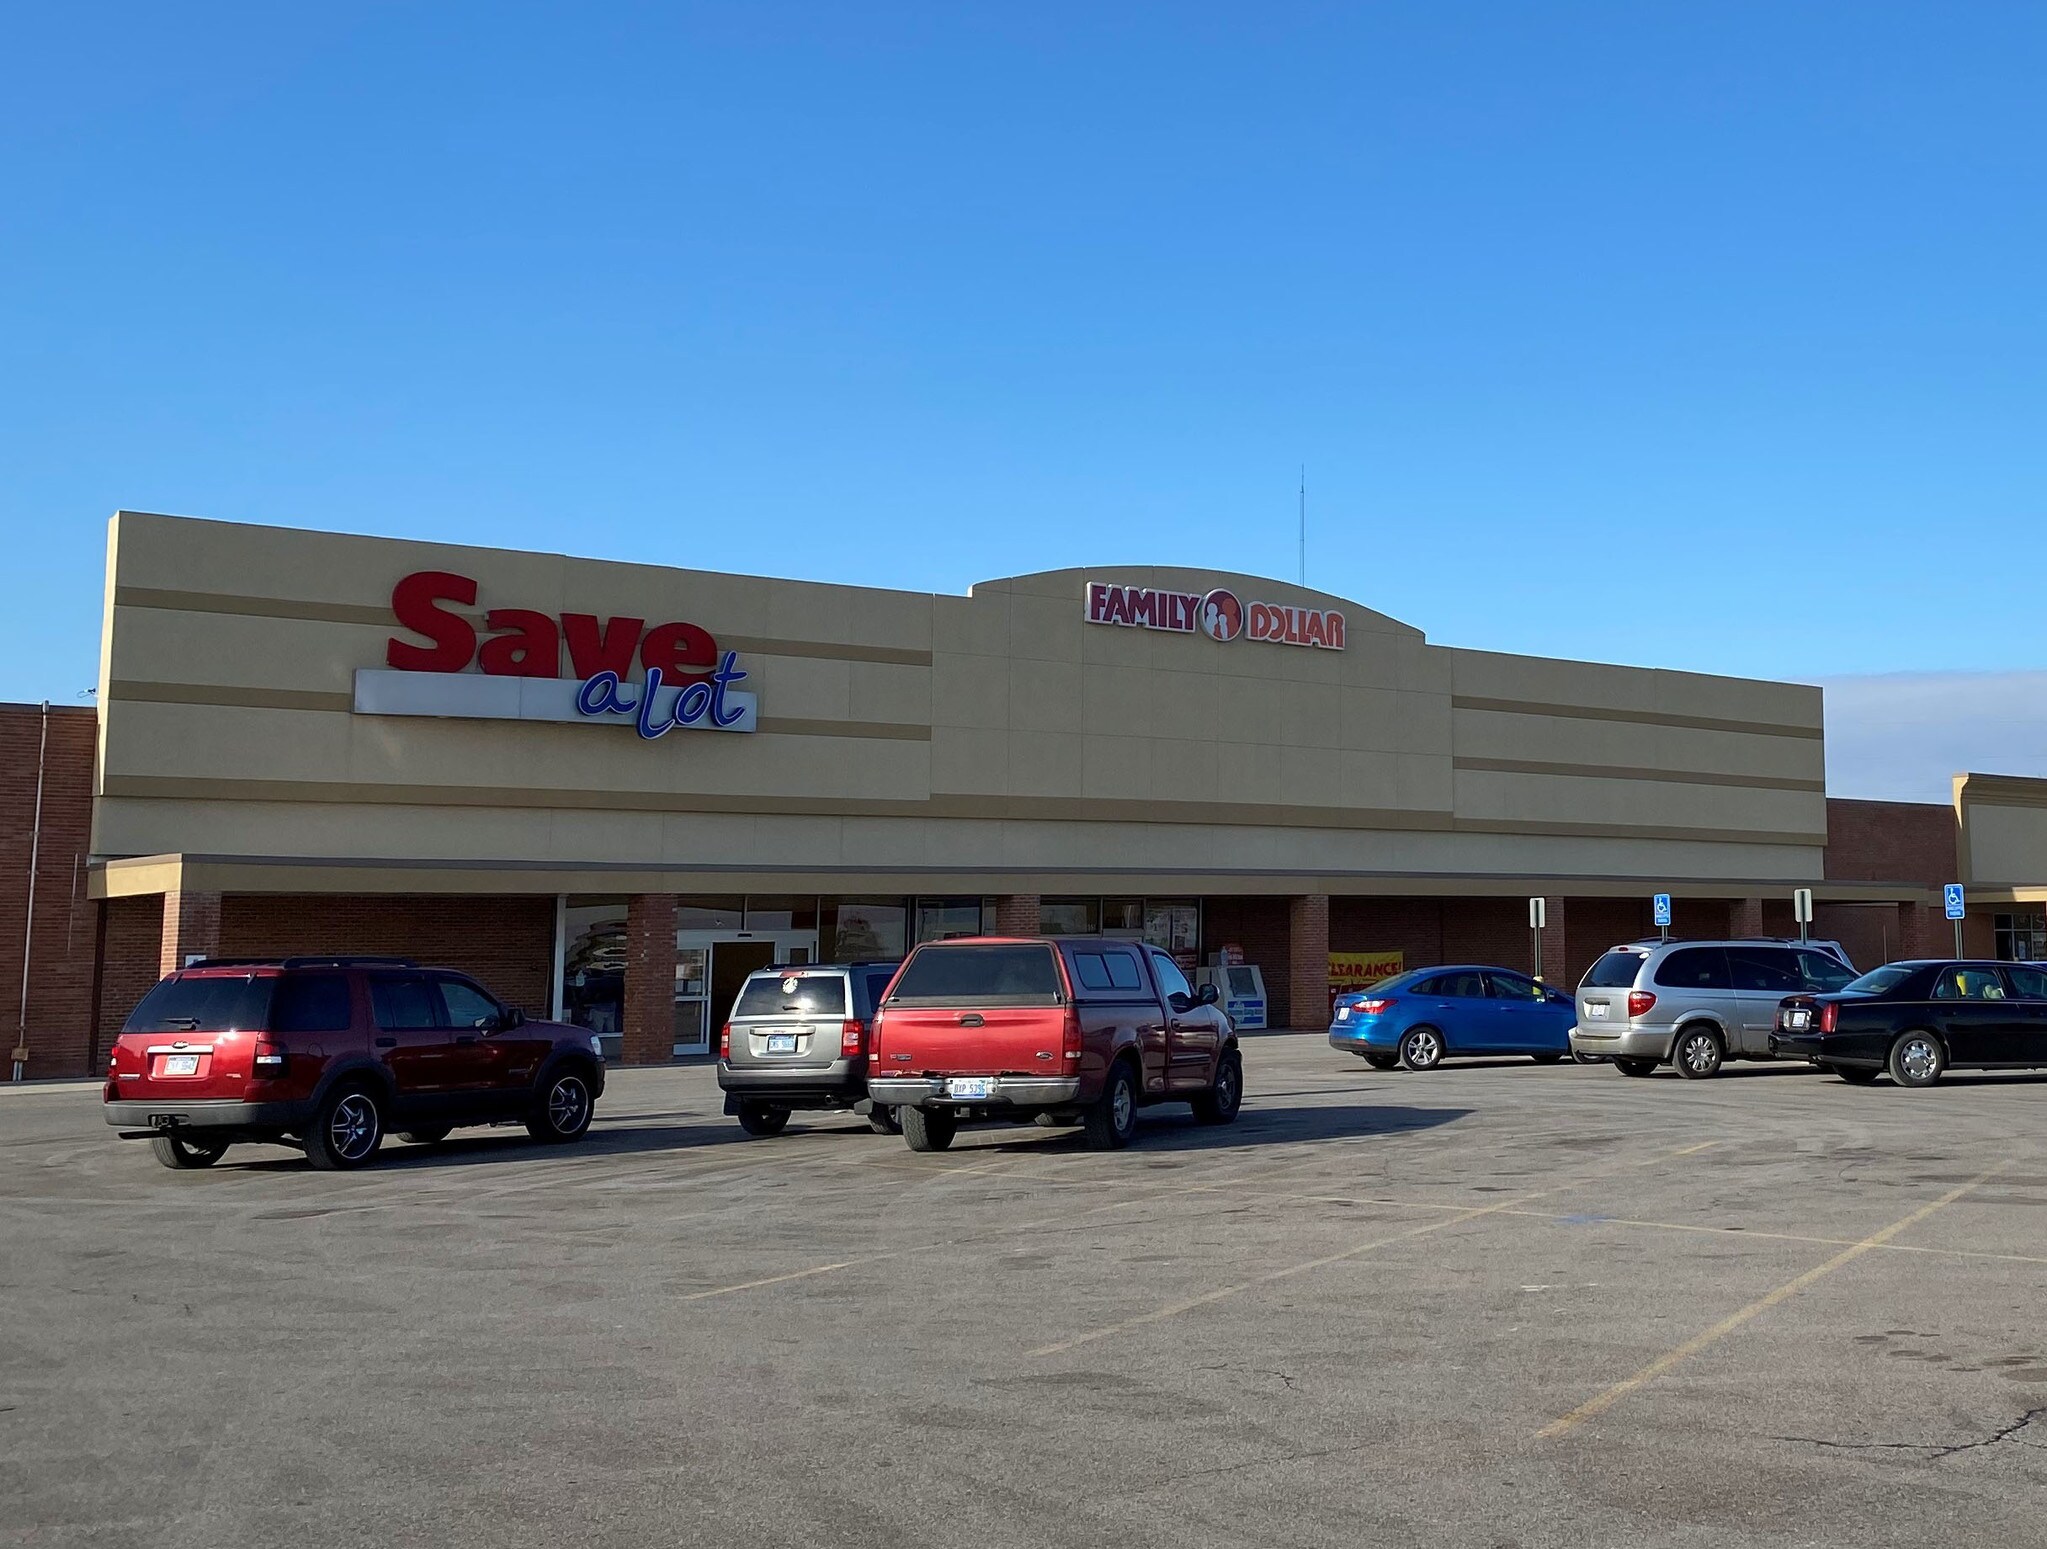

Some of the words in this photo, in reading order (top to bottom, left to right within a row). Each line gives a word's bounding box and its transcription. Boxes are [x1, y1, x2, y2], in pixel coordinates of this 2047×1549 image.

[386, 570, 718, 686] Save
[1089, 584, 1200, 631] FAMILY
[1249, 602, 1344, 648] DOLLAR
